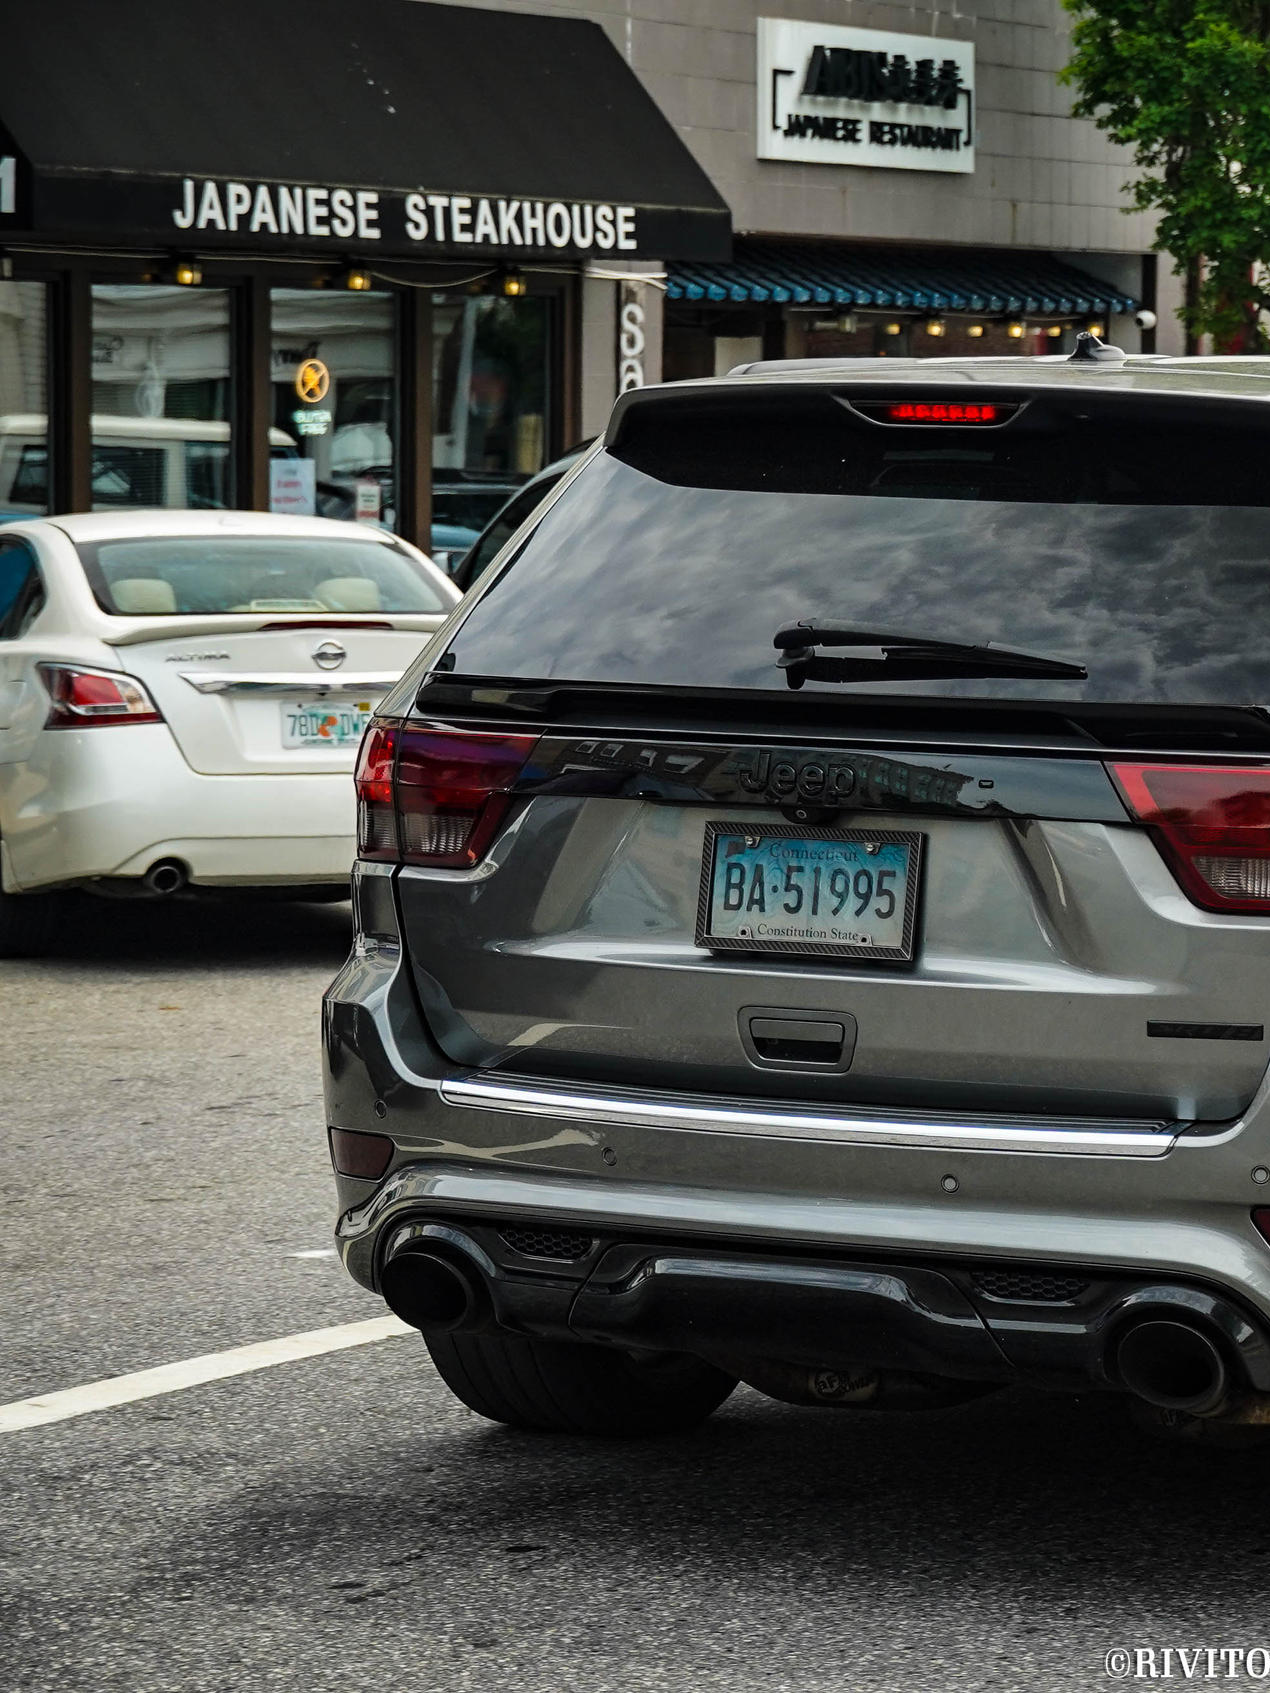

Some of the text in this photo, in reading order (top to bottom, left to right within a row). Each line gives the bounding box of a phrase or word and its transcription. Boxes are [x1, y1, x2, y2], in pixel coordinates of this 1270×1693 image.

[783, 114, 963, 151] JAPANESE RESTAURANT
[172, 178, 638, 250] JAPANESE STEAKHOUSE
[165, 652, 231, 662] ALTIMA
[738, 752, 856, 807] Jeep
[769, 843, 858, 862] Connecticut
[757, 923, 859, 941] Constitution State
